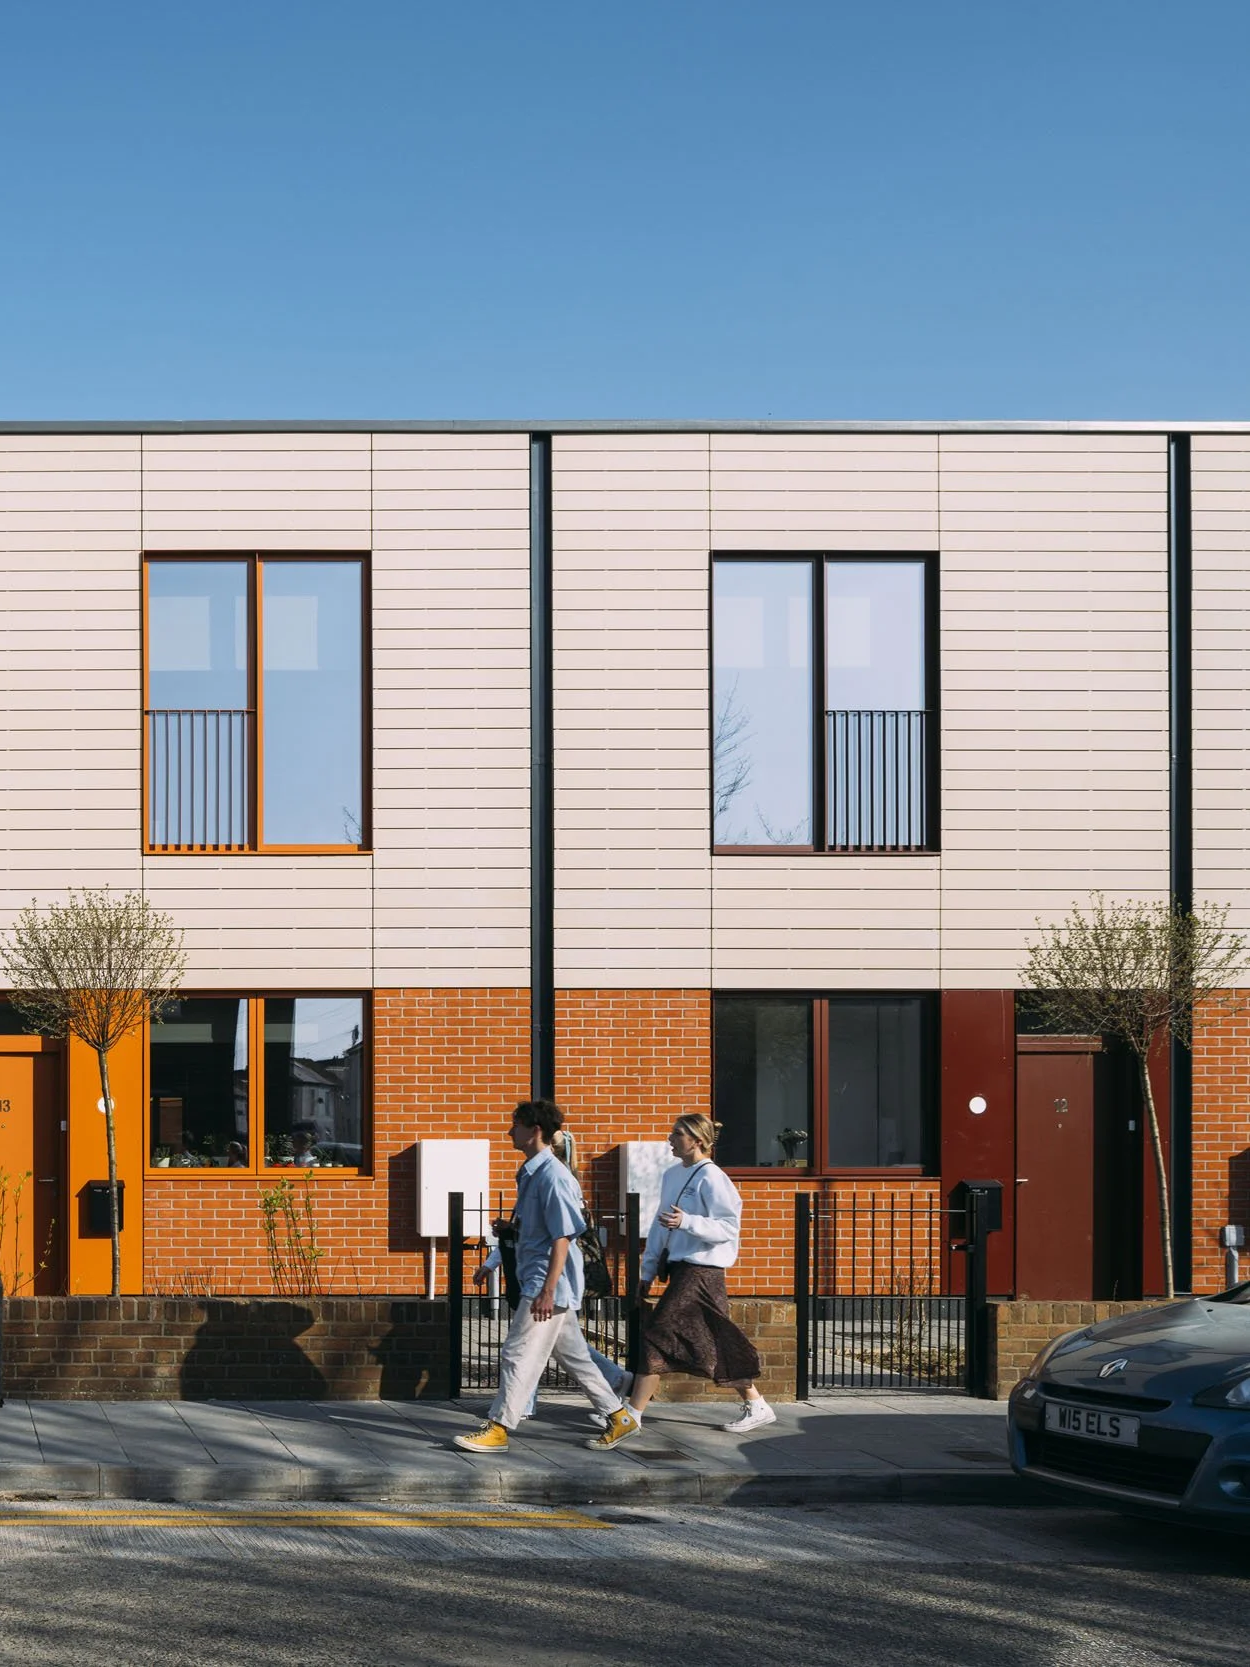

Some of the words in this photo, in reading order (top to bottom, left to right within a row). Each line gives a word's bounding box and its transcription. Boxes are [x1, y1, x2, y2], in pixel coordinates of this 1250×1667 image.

[1053, 1098, 1069, 1113] 12
[1058, 1407, 1082, 1432] W15
[1085, 1412, 1121, 1439] ELS
